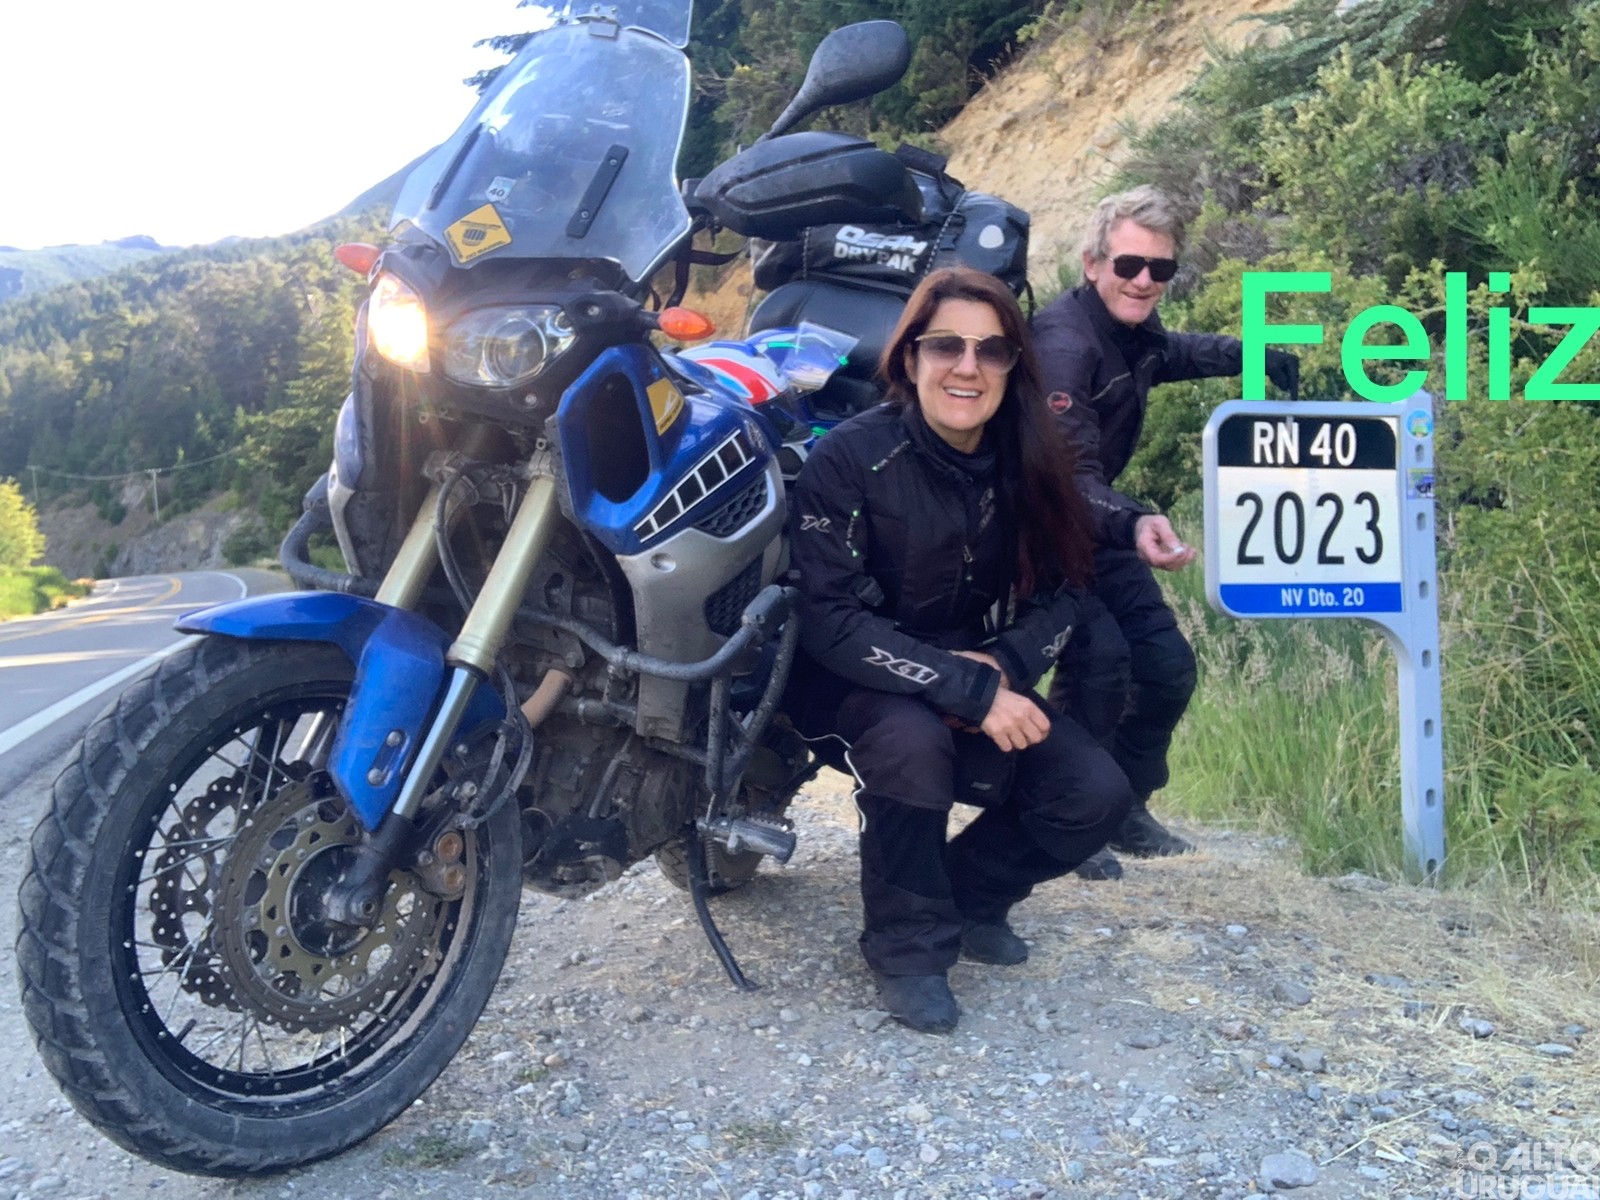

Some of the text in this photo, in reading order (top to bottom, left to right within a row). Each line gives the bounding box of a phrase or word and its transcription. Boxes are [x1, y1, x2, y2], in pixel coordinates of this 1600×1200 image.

[488, 187, 506, 198] 40
[833, 241, 918, 273] DRYPAK
[1253, 422, 1357, 466] RN 40
[1235, 491, 1384, 566] 2023
[1281, 588, 1365, 608] NV Dto. 20
